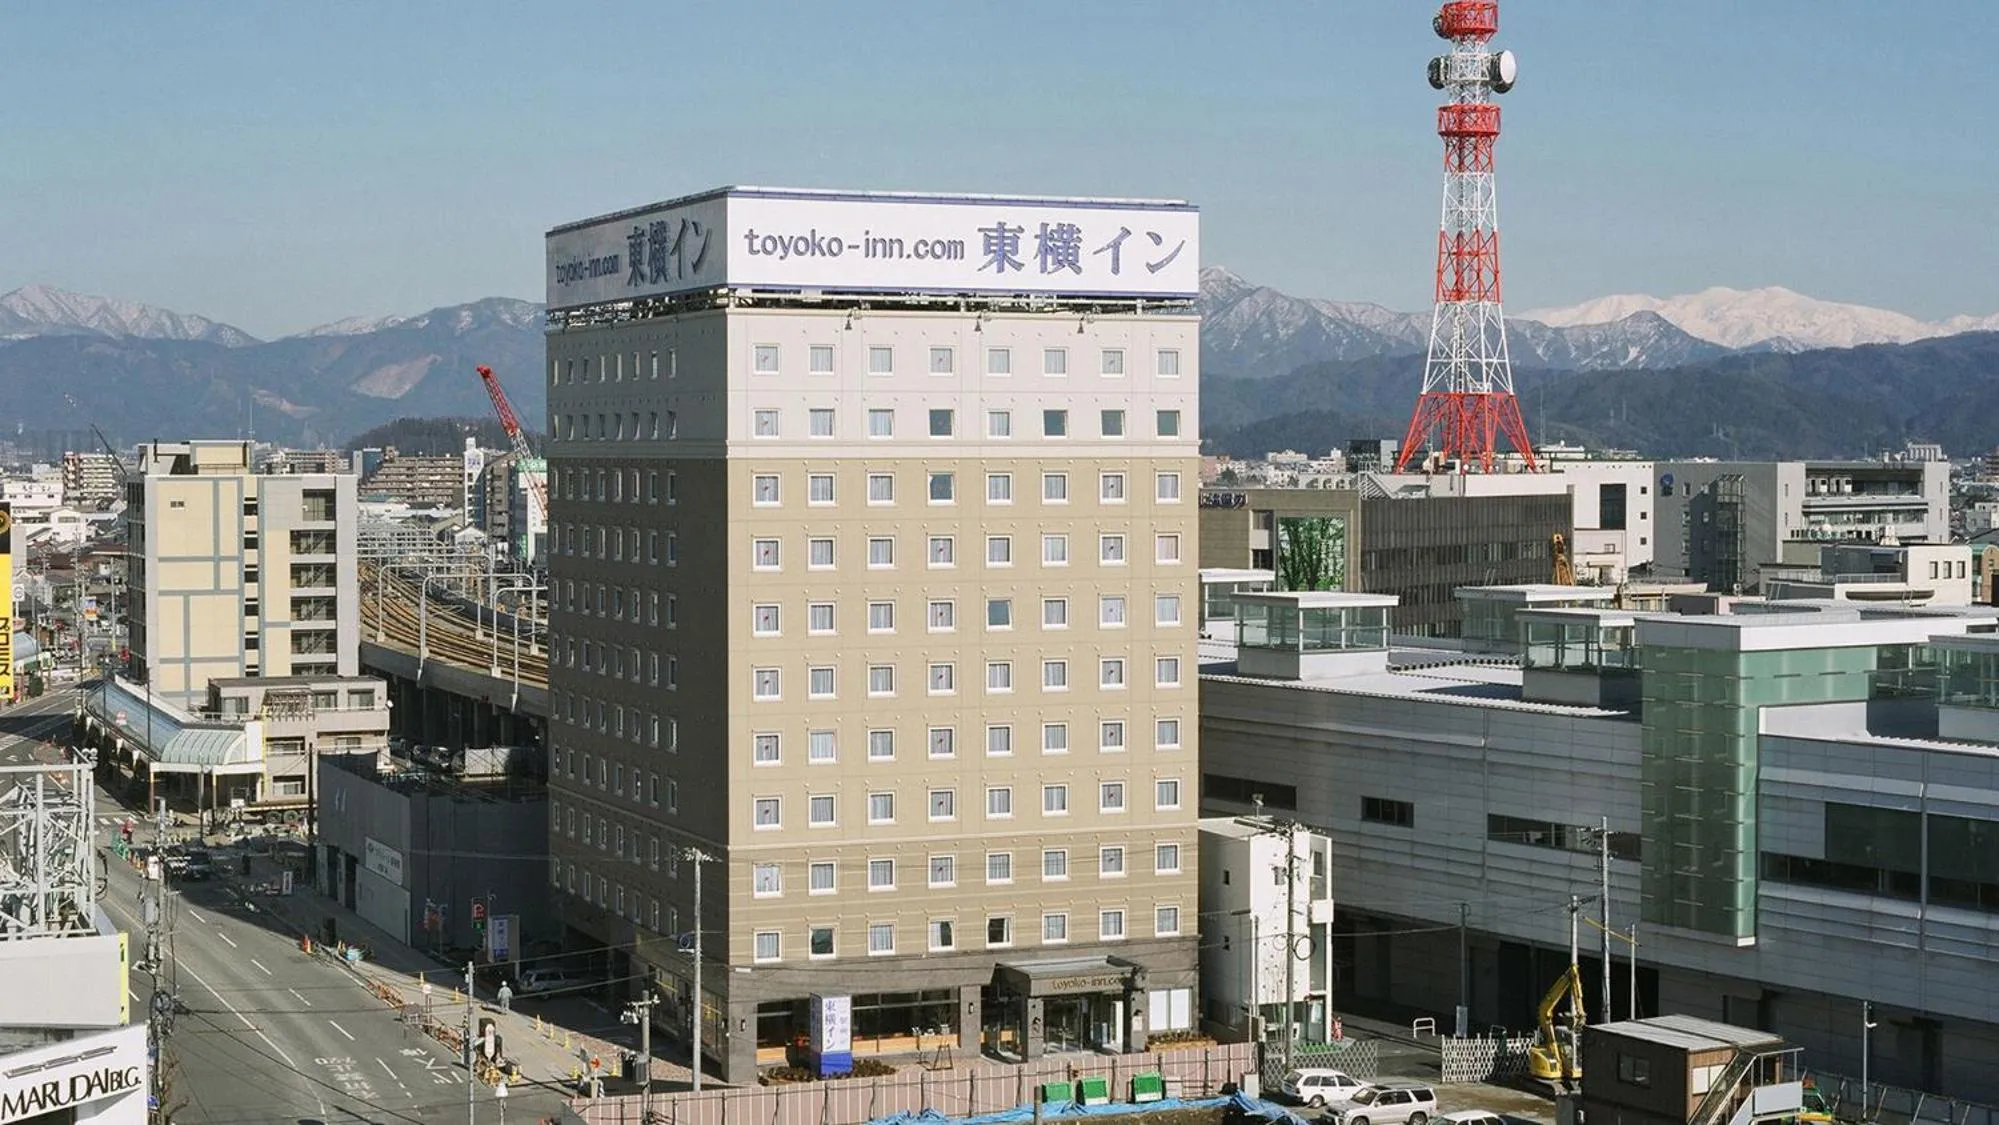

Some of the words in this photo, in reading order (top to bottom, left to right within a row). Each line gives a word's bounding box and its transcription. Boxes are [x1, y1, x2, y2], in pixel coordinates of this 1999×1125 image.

[556, 252, 619, 287] toyoko-inn.com
[626, 217, 712, 287] 東横イン
[744, 229, 965, 261] toyoko-inn.com
[981, 221, 1186, 275] 東横イン
[825, 1000, 836, 1050] 東横イン
[1, 1067, 109, 1120] MARUDAI
